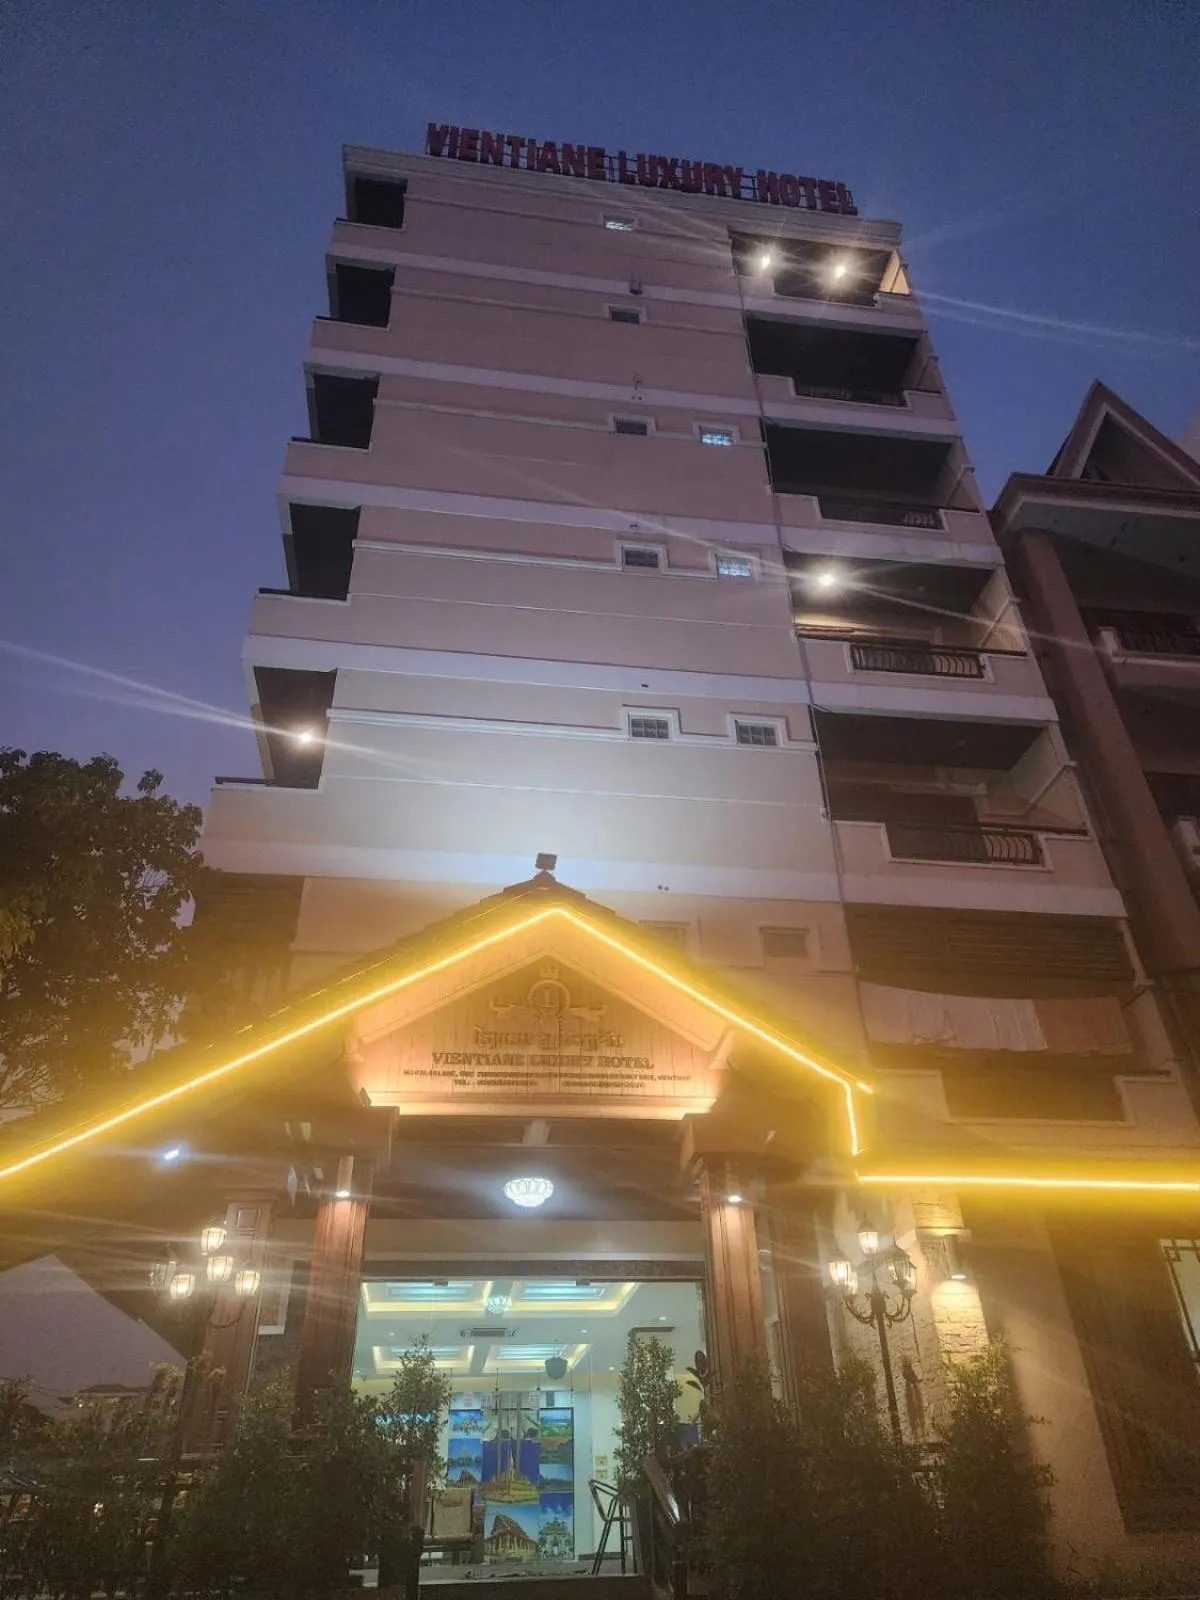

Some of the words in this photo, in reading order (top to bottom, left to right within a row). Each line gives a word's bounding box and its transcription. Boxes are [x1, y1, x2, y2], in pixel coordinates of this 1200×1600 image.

[426, 122, 606, 180] VIENTIANE
[618, 151, 744, 199] LUXURY
[755, 168, 858, 216] HOTEL
[432, 1052, 526, 1066] VIENTIANE
[597, 1055, 655, 1070] HOTEL
